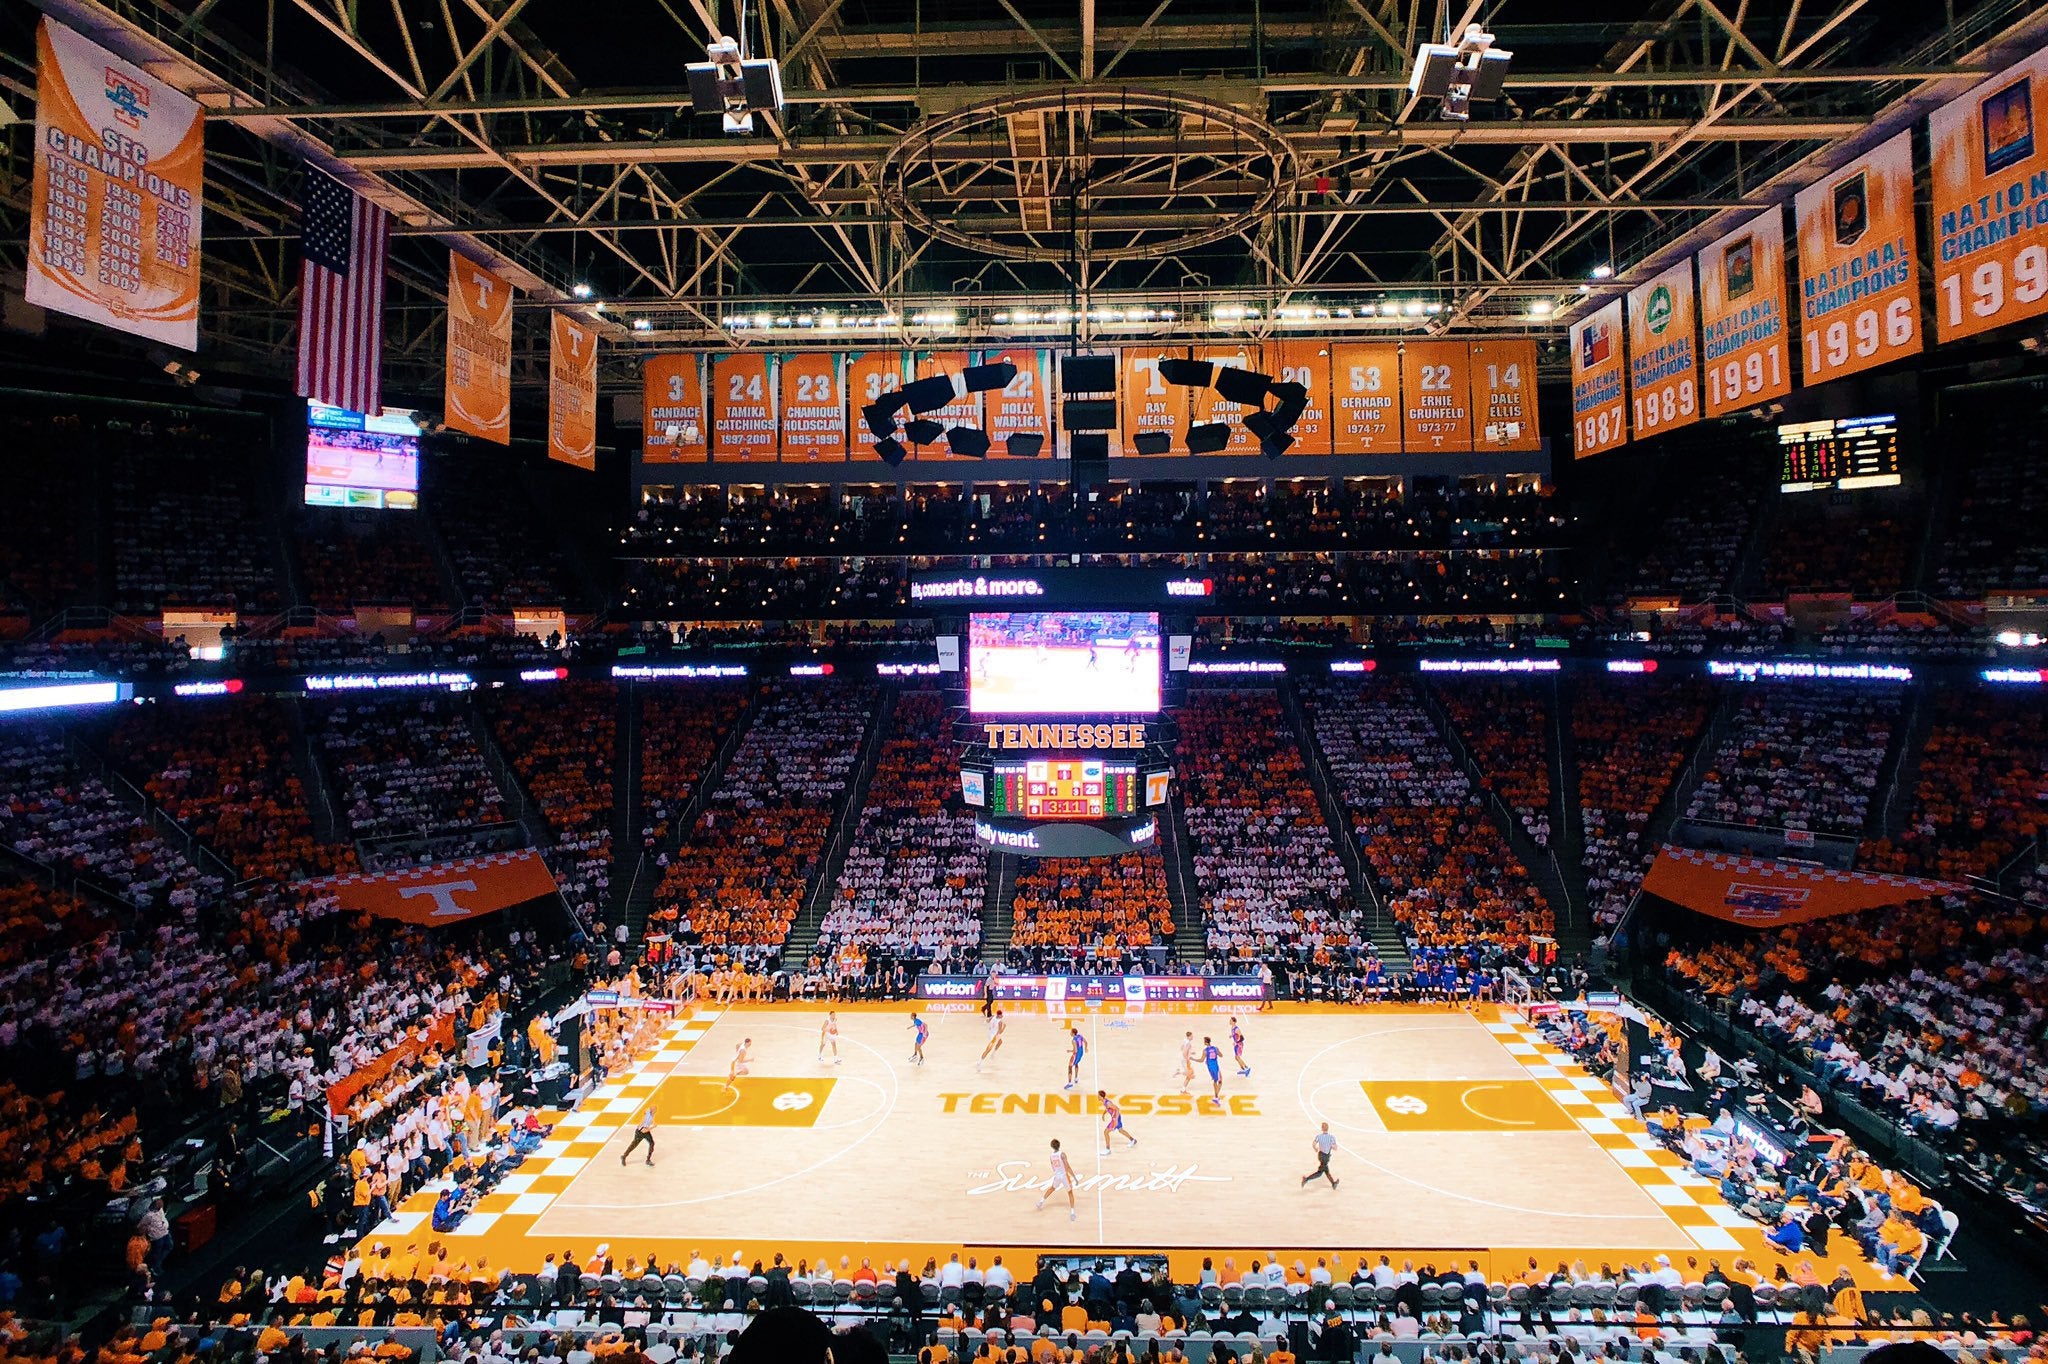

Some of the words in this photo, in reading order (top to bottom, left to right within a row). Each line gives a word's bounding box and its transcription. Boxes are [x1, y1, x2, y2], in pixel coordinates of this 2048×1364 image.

[102, 128, 148, 166] SEC
[47, 126, 191, 210] CHAMPIONS
[48, 154, 88, 183] 1980
[47, 187, 87, 214] 1990
[104, 195, 140, 220] 2000
[46, 218, 86, 244] 1994
[102, 210, 140, 235] 2001
[101, 225, 141, 250] 2002
[101, 240, 140, 265] 2003
[156, 247, 188, 268] 2015
[100, 255, 140, 280] 2004
[1804, 237, 1909, 298] NATIONAL
[99, 270, 139, 294] 2007
[473, 272, 493, 310] T
[1806, 260, 1910, 319] CHAMPIONS
[1705, 295, 1779, 341] NATIONAL
[568, 326, 584, 357] T
[1706, 316, 1781, 361] CHAMPIONS
[1806, 296, 1913, 374] 1996
[1634, 336, 1691, 371] NATIONAL
[1283, 367, 1311, 391] 20
[1350, 365, 1381, 392] 53
[1421, 365, 1451, 391] 22
[1487, 363, 1521, 389] 14
[1634, 353, 1693, 390] CHAMPIONS
[1709, 345, 1781, 406] 1991
[668, 374, 684, 401] 3
[729, 374, 763, 401] 24
[797, 374, 831, 402] 23
[1575, 367, 1621, 398] NATIONAL
[1212, 401, 1241, 412] JOHN
[1341, 397, 1392, 408] BERNARD
[1421, 395, 1453, 407] ERNIE
[1490, 393, 1520, 404] DALE
[1575, 383, 1621, 413] CHAMPIONS
[1635, 379, 1695, 431] 1989
[651, 407, 700, 418] CANDACE
[726, 406, 766, 418] TAMIKA
[787, 406, 841, 418] CHAMIQUE
[1002, 403, 1035, 414] HOLLY
[1146, 402, 1166, 413] RAY
[1353, 409, 1380, 420] KING
[1409, 408, 1465, 420] GRUNFELD
[1490, 406, 1522, 417] ELLIS
[716, 419, 776, 431] CATCHINGS
[784, 419, 844, 431] HOLDSCLAW
[993, 415, 1042, 427] WARLICK
[1138, 414, 1175, 426] MEARS
[1211, 414, 1243, 424] WARD
[1417, 423, 1456, 433] 1973-77
[1346, 424, 1386, 434] 1974-77
[1575, 405, 1623, 452] 1987
[721, 434, 771, 445] 1997-2001
[787, 434, 840, 445] 1995-1999
[923, 579, 973, 597] concerts
[974, 576, 988, 596] &
[989, 579, 1043, 596] more.
[1167, 577, 1205, 596] verizon
[612, 666, 652, 677] Rewards
[652, 667, 670, 679] you
[670, 665, 696, 678] really,
[697, 665, 721, 677] really
[721, 666, 747, 677] want.
[790, 666, 822, 676] verizon
[877, 664, 897, 674] Text
[918, 664, 928, 674] to
[1208, 662, 1250, 672] concerts
[1258, 663, 1286, 672] more.
[1330, 661, 1364, 672] verizon
[1420, 660, 1462, 671] Rewards
[1462, 661, 1480, 672] you
[1508, 659, 1533, 672] really
[1608, 660, 1643, 672] verizon
[1709, 661, 1735, 674] Text
[1762, 663, 1775, 676] to
[1816, 664, 1830, 677] to
[1831, 664, 1869, 678] enroll
[1869, 665, 1912, 680] today.
[306, 676, 333, 689] Vols
[334, 675, 377, 689] tickets,
[377, 673, 428, 687] concerts
[429, 672, 438, 685] &
[439, 673, 471, 684] more.
[521, 669, 557, 681] verizon
[1985, 668, 2041, 682] verizon
[175, 682, 226, 695] verizon
[984, 723, 1145, 749] TENNESSEE
[1048, 801, 1081, 813] 3:11
[997, 831, 1040, 849] want.
[398, 880, 477, 916] T
[925, 981, 976, 995] verizon
[1070, 984, 1082, 993] 34
[1087, 987, 1104, 995] 3:11
[1108, 984, 1120, 993] 23
[1210, 982, 1262, 997] verizon
[936, 1093, 1262, 1116] TENNESSEE
[1736, 1121, 1786, 1166] verizon
[967, 1171, 990, 1179] THE
